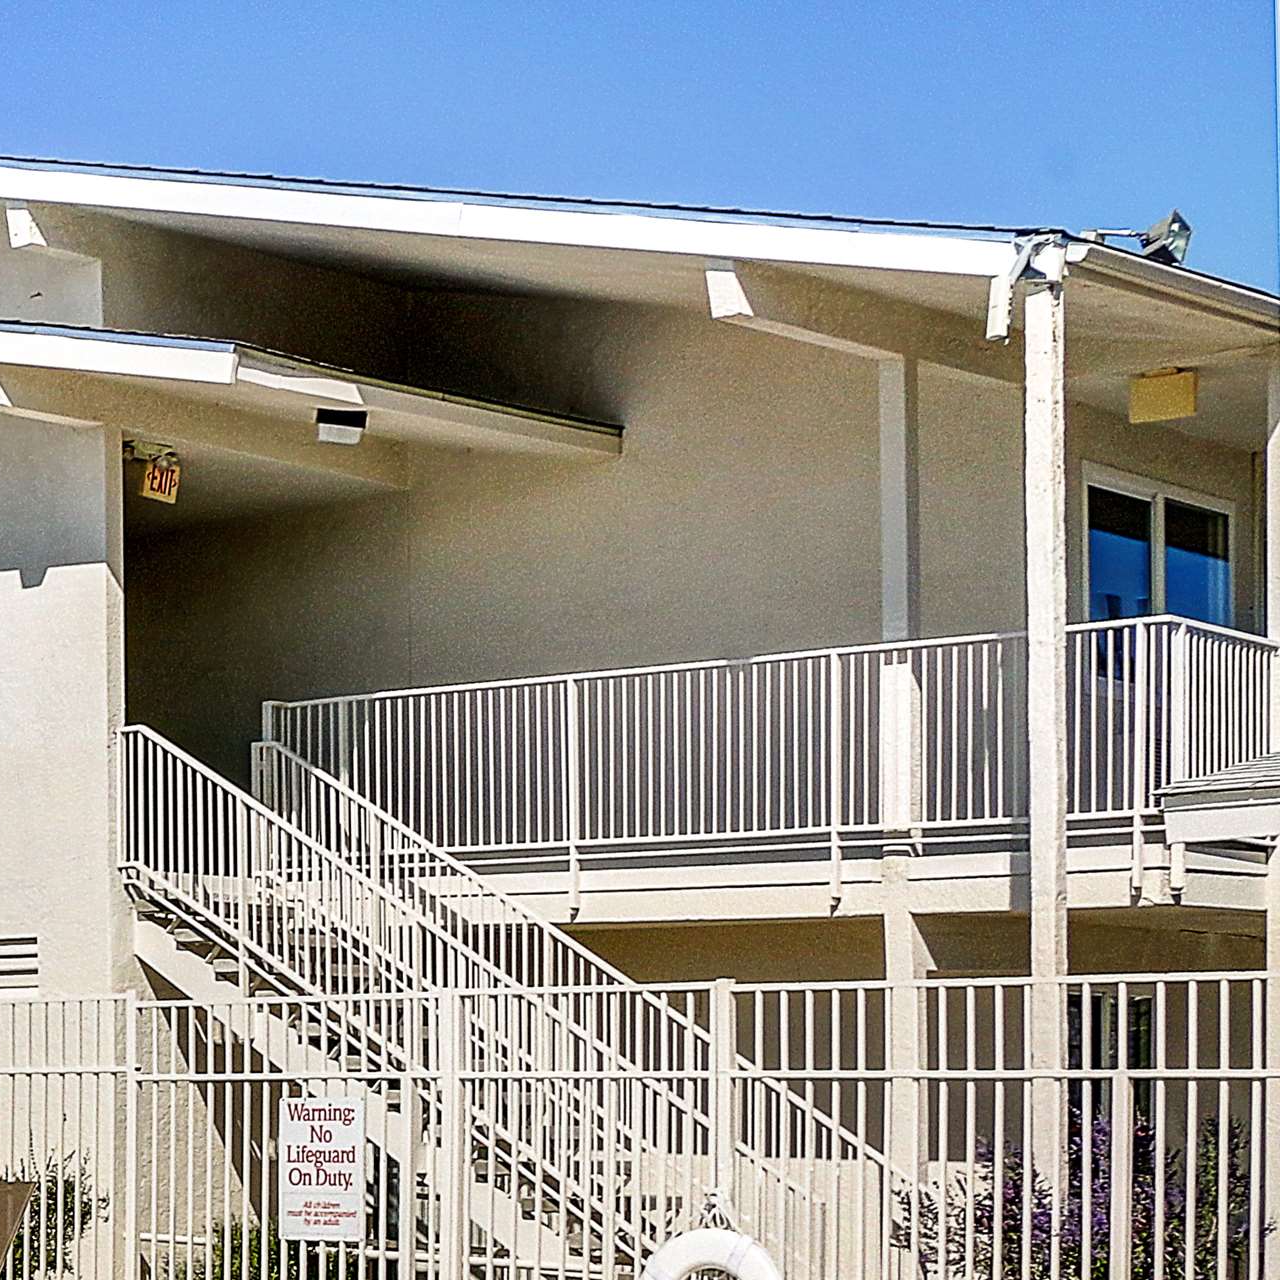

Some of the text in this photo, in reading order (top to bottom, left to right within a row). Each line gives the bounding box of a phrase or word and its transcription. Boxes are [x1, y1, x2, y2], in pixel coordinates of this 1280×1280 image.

[149, 463, 176, 496] EXIT
[287, 1102, 355, 1126] Warning:
[310, 1125, 333, 1143] No
[287, 1145, 356, 1168] Lifeguard
[288, 1168, 353, 1191] On Duty.
